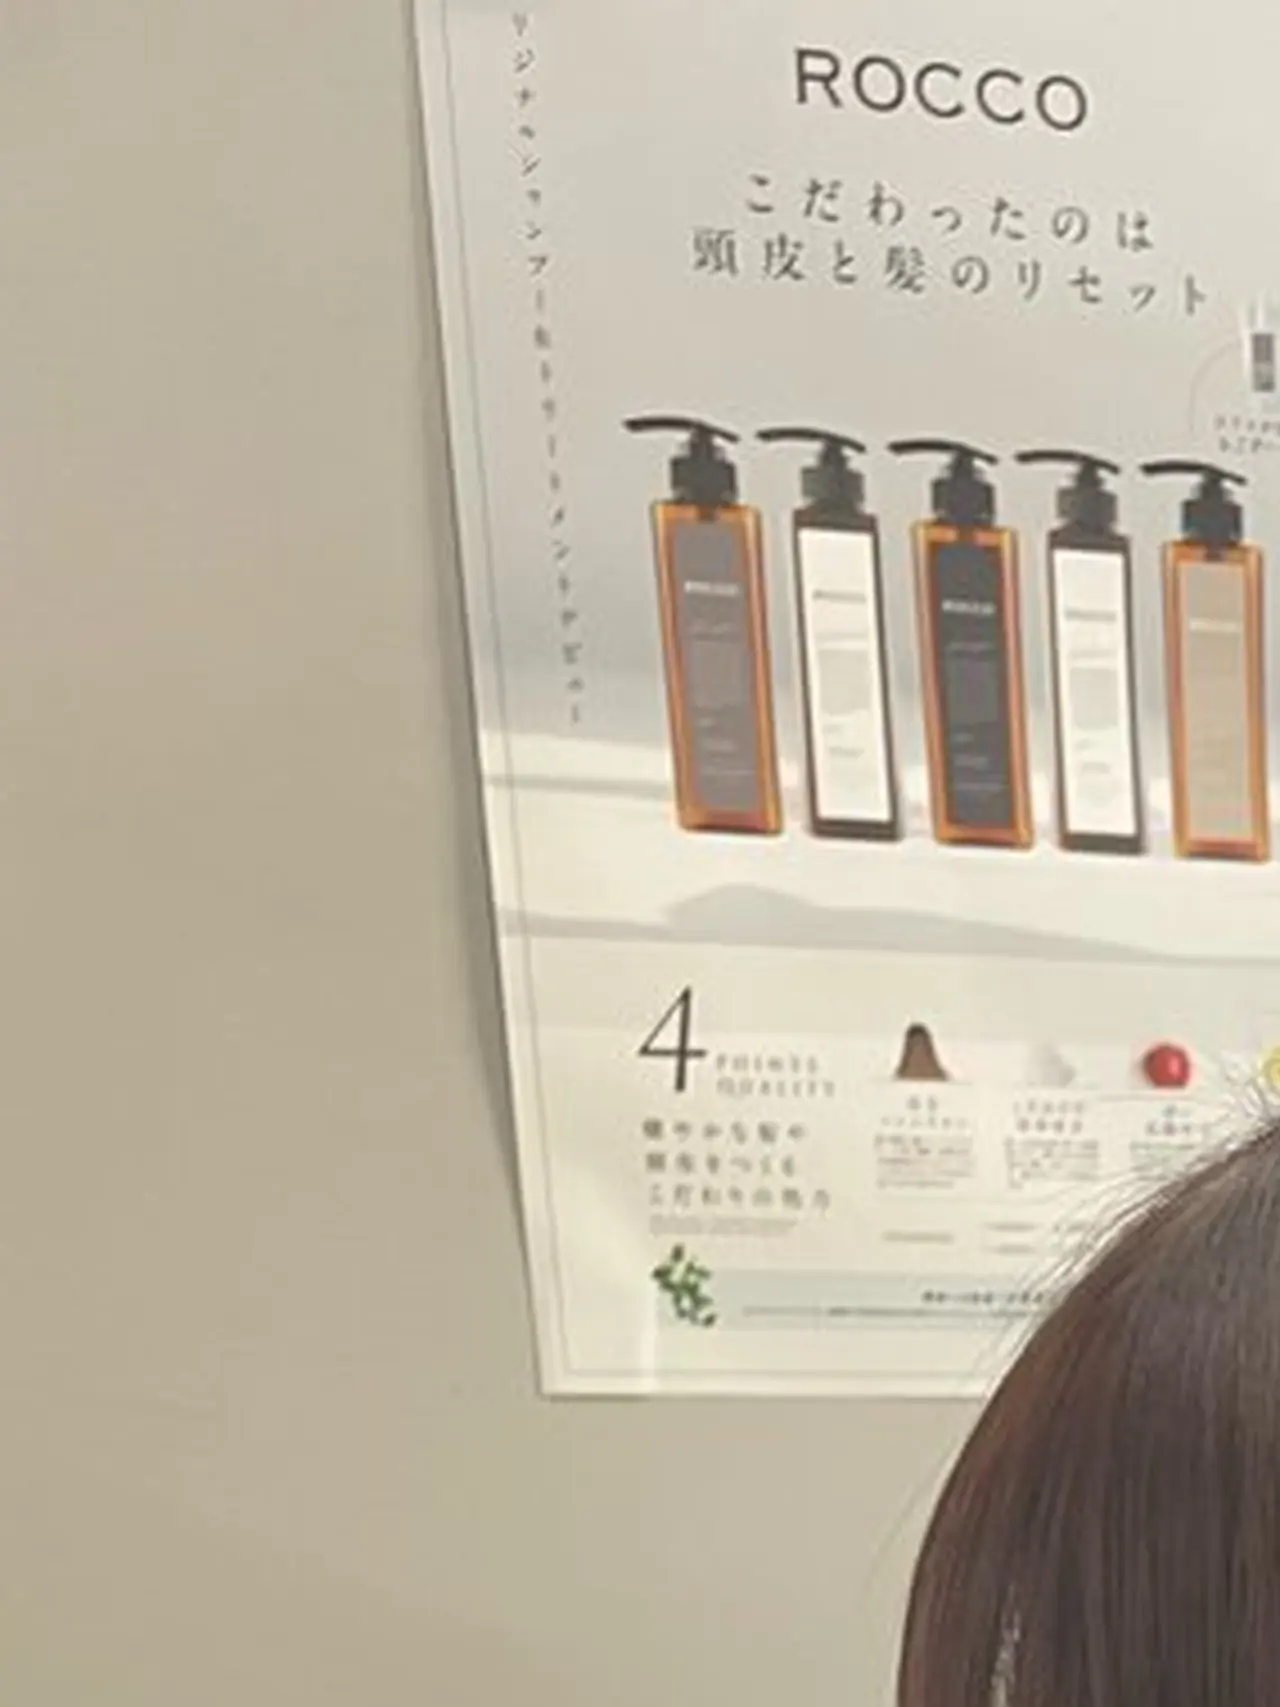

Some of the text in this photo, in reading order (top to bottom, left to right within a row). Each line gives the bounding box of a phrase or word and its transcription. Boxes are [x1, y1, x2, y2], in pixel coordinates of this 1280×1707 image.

[794, 48, 1087, 131] ROCCO
[745, 173, 1154, 252] こだわったのは
[692, 226, 1208, 317] 頭皮と髪のリセット
[637, 984, 708, 1093] 4
